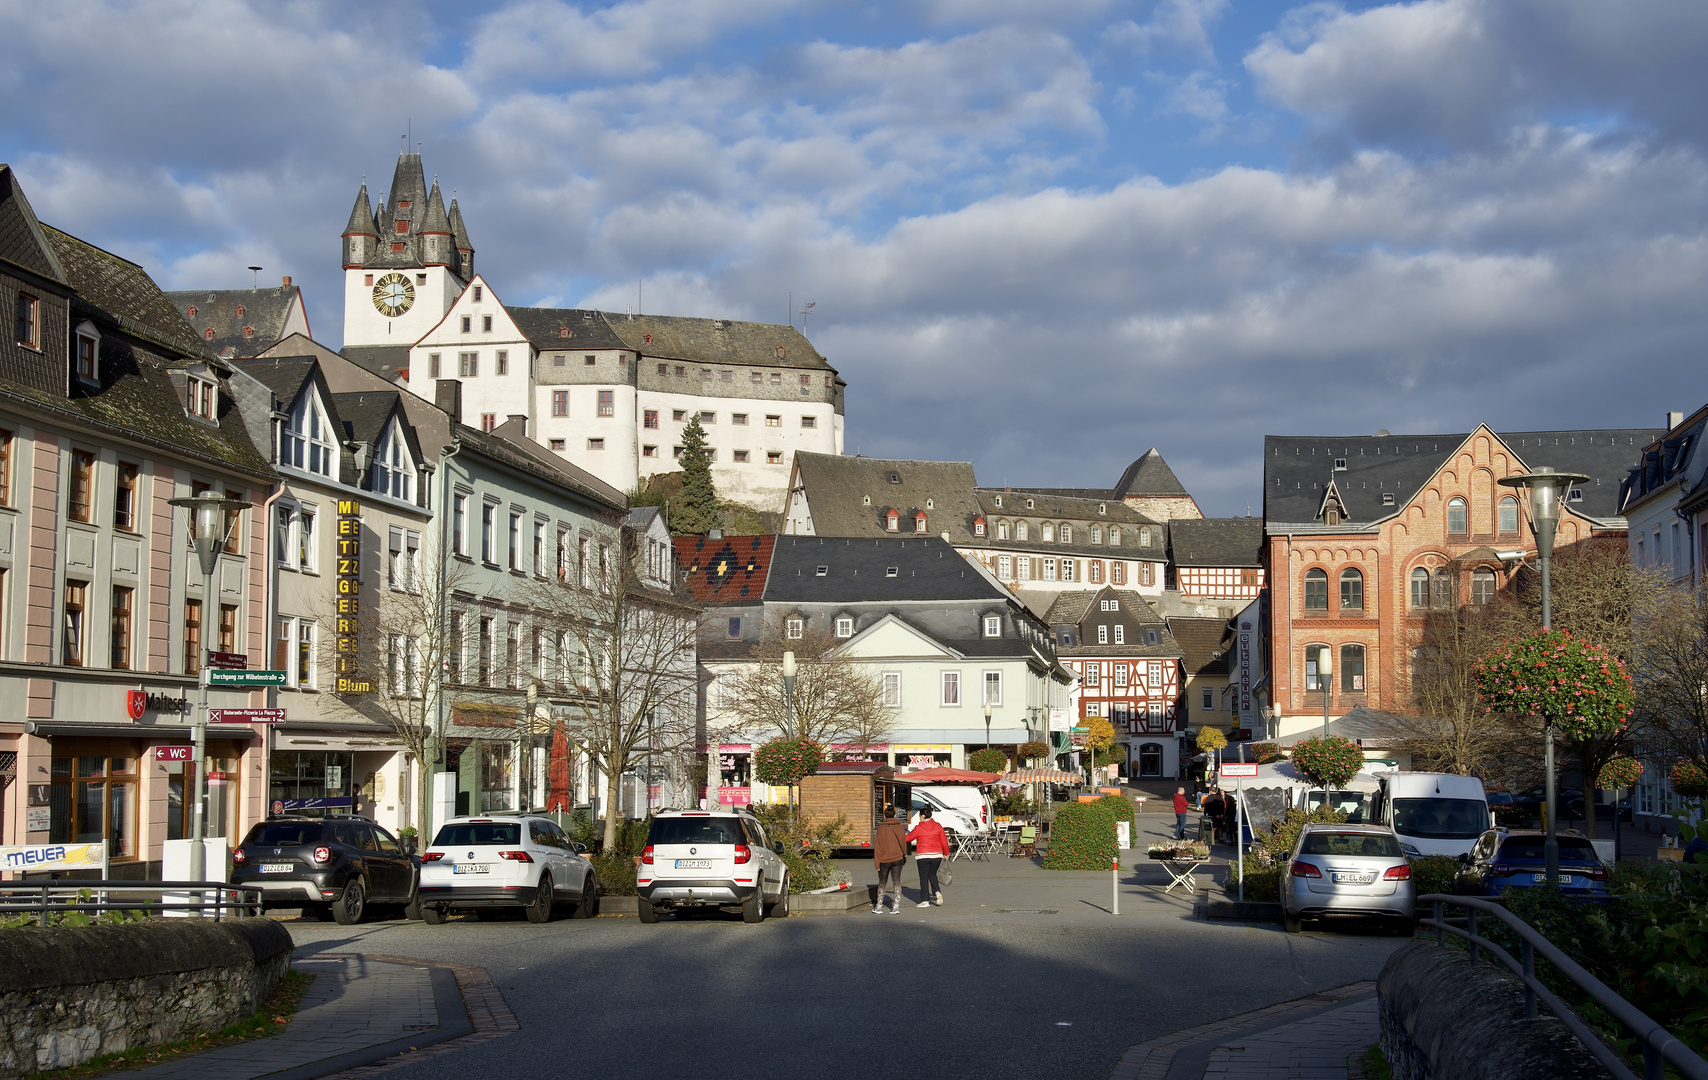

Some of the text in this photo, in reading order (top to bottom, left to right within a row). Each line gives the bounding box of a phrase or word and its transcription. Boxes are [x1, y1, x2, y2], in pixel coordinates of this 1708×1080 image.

[212, 673, 236, 681] Durchgang
[1241, 634, 1250, 710] euteneuer
[338, 678, 370, 692] Blum
[146, 692, 187, 711] Malteser
[170, 748, 186, 758] WC
[7, 846, 66, 866] MEUER
